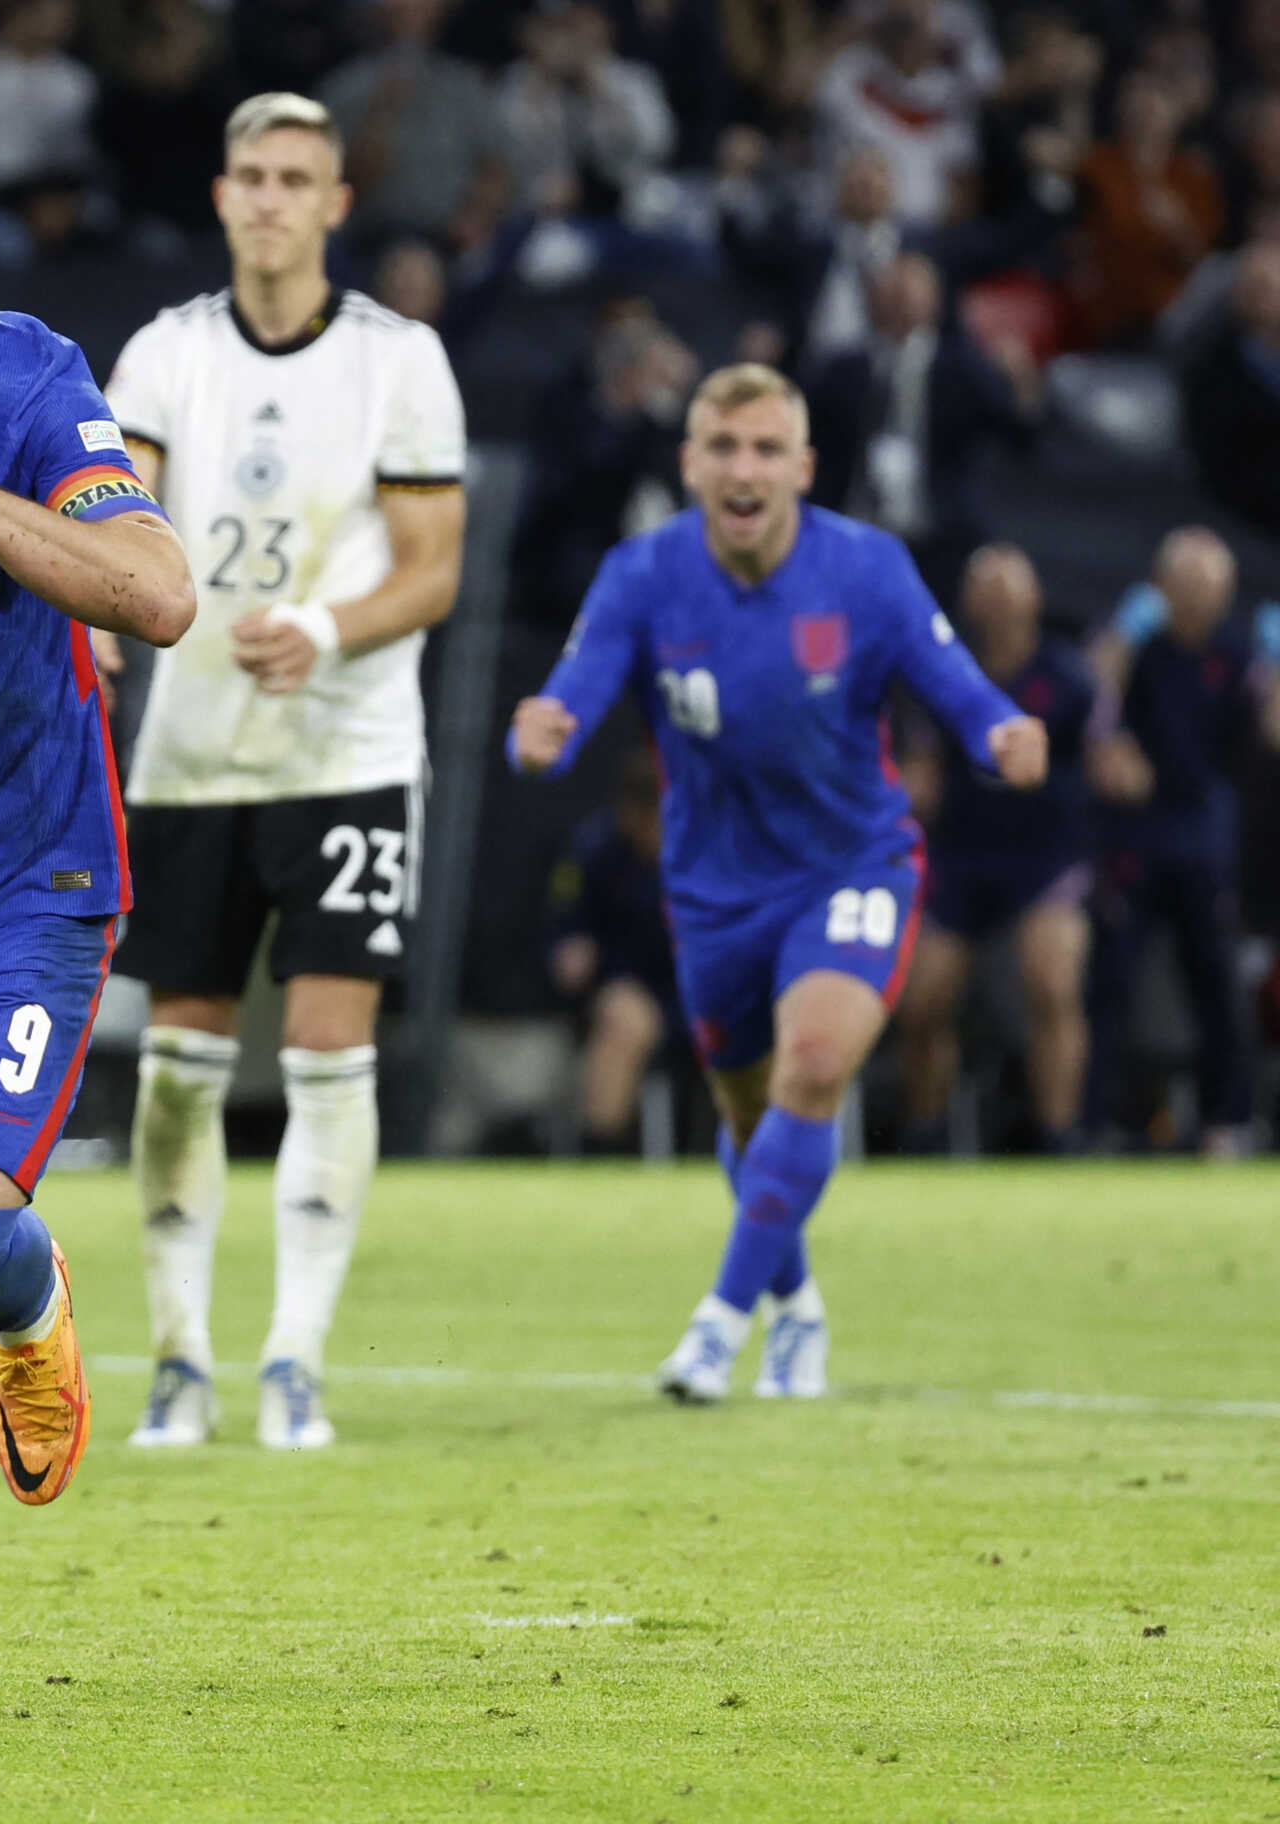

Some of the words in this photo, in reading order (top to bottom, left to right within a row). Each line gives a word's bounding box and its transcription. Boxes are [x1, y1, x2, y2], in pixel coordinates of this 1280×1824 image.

[60, 481, 156, 518] PTAIN
[208, 513, 291, 592] 23
[319, 824, 404, 914] 23
[825, 887, 897, 947] 20
